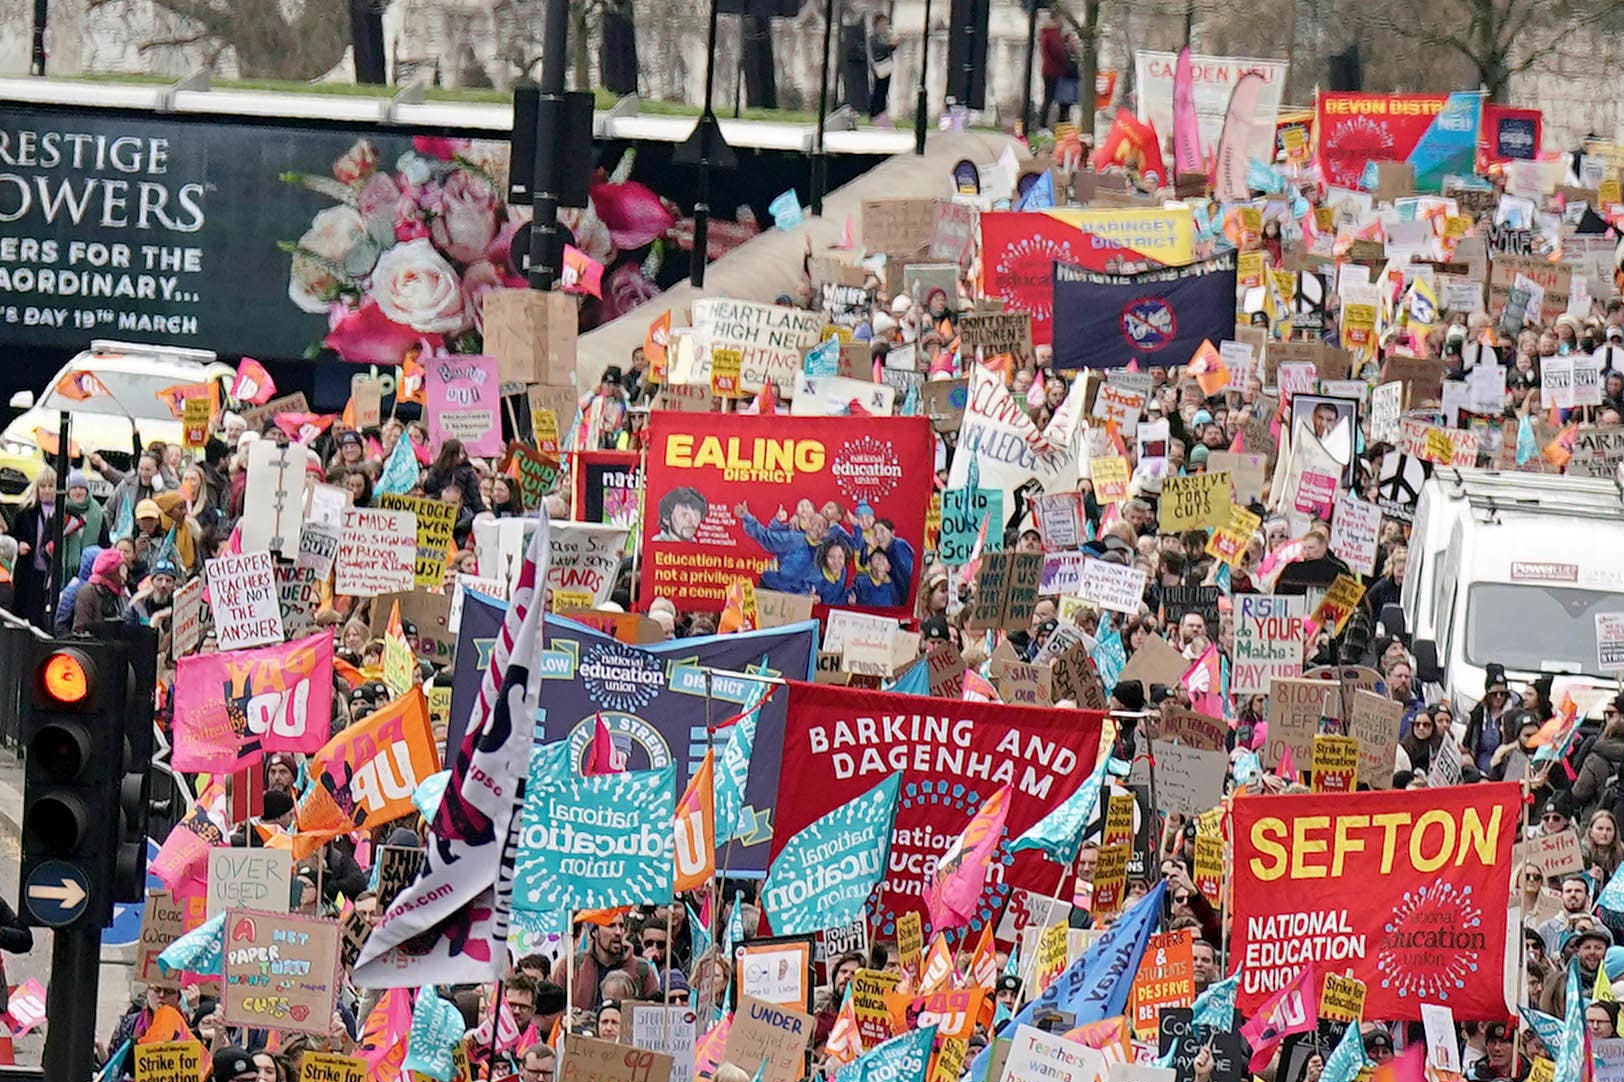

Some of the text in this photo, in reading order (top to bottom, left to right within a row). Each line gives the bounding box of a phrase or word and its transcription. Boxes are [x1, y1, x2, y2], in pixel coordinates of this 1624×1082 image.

[1080, 219, 1177, 235] HARINGEY
[1090, 235, 1178, 250] DISTRICT
[69, 241, 203, 273] FOR THE
[23, 306, 198, 335] DAY MARCH
[710, 300, 823, 334] HEARTLANDS
[713, 321, 759, 343] HIGH
[665, 434, 825, 473] EALING
[724, 468, 795, 484] DISTRICT
[832, 462, 902, 478] education
[1161, 473, 1228, 493] MASSIVE
[1174, 502, 1212, 519] CUTS
[358, 512, 399, 532] MADE
[942, 516, 980, 536] OUR
[301, 537, 337, 560] OUT!
[208, 552, 271, 580] CHEAPER
[655, 551, 722, 569] Education
[723, 554, 734, 568] is
[746, 556, 779, 573] right
[215, 574, 271, 595] TEACHERS
[655, 568, 677, 582] not
[217, 587, 270, 609] ARE NOT
[654, 585, 675, 597] nor
[229, 604, 256, 621] THE
[220, 618, 281, 643] ANSWER
[1253, 616, 1302, 642] YOUR
[601, 652, 644, 668] national
[929, 653, 957, 672] THE
[579, 662, 666, 686] education
[1011, 667, 1039, 684] SAVE
[1233, 663, 1267, 690] PAY
[603, 680, 637, 694] union
[1015, 688, 1037, 703] OUR
[808, 715, 1078, 777] BARKING AND
[1315, 742, 1346, 755] Strike
[832, 744, 1054, 800] DAGENHAM
[1314, 755, 1358, 768] education
[1249, 804, 1504, 882] SEFTON
[214, 854, 284, 883] OVER
[215, 881, 269, 900] USED
[232, 917, 257, 945] A
[1247, 909, 1353, 941] NATIONAL
[827, 932, 864, 953] OUT!
[1246, 934, 1367, 969] EDUCATION
[227, 944, 280, 967] PAPER
[1138, 978, 1190, 1001] DESERVE
[1325, 977, 1353, 996] Strike
[749, 1002, 804, 1035] UNDER
[1028, 1035, 1088, 1069] Teachers
[138, 1053, 199, 1074] Strike for
[304, 1063, 341, 1082] Strike
